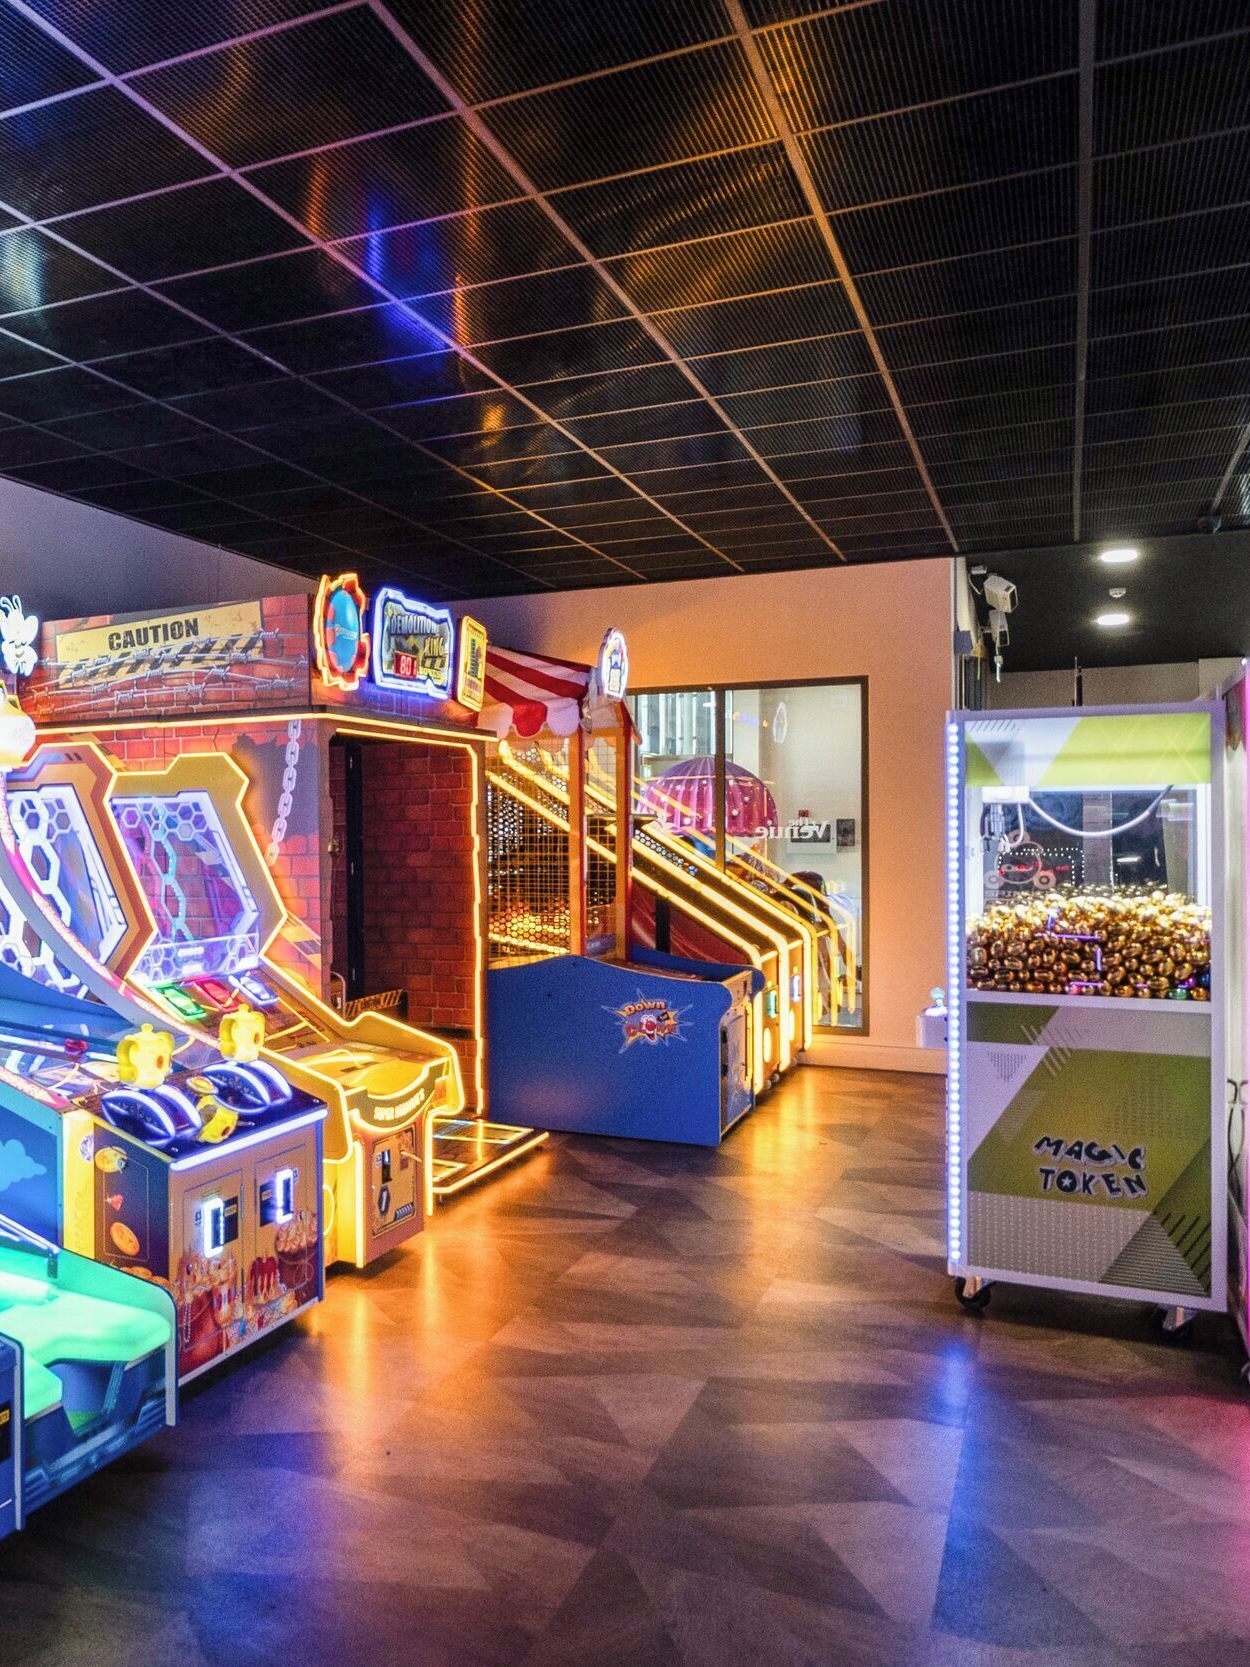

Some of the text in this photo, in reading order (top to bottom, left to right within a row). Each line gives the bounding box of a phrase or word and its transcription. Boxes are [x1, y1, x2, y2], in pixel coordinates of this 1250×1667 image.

[107, 617, 200, 651] CAUTION
[390, 613, 437, 635] DEMOLITION
[424, 636, 444, 657] KING
[624, 1000, 666, 1016] Down
[1034, 1135, 1144, 1170] MAGIC
[1039, 1167, 1147, 1196] TOKEN
